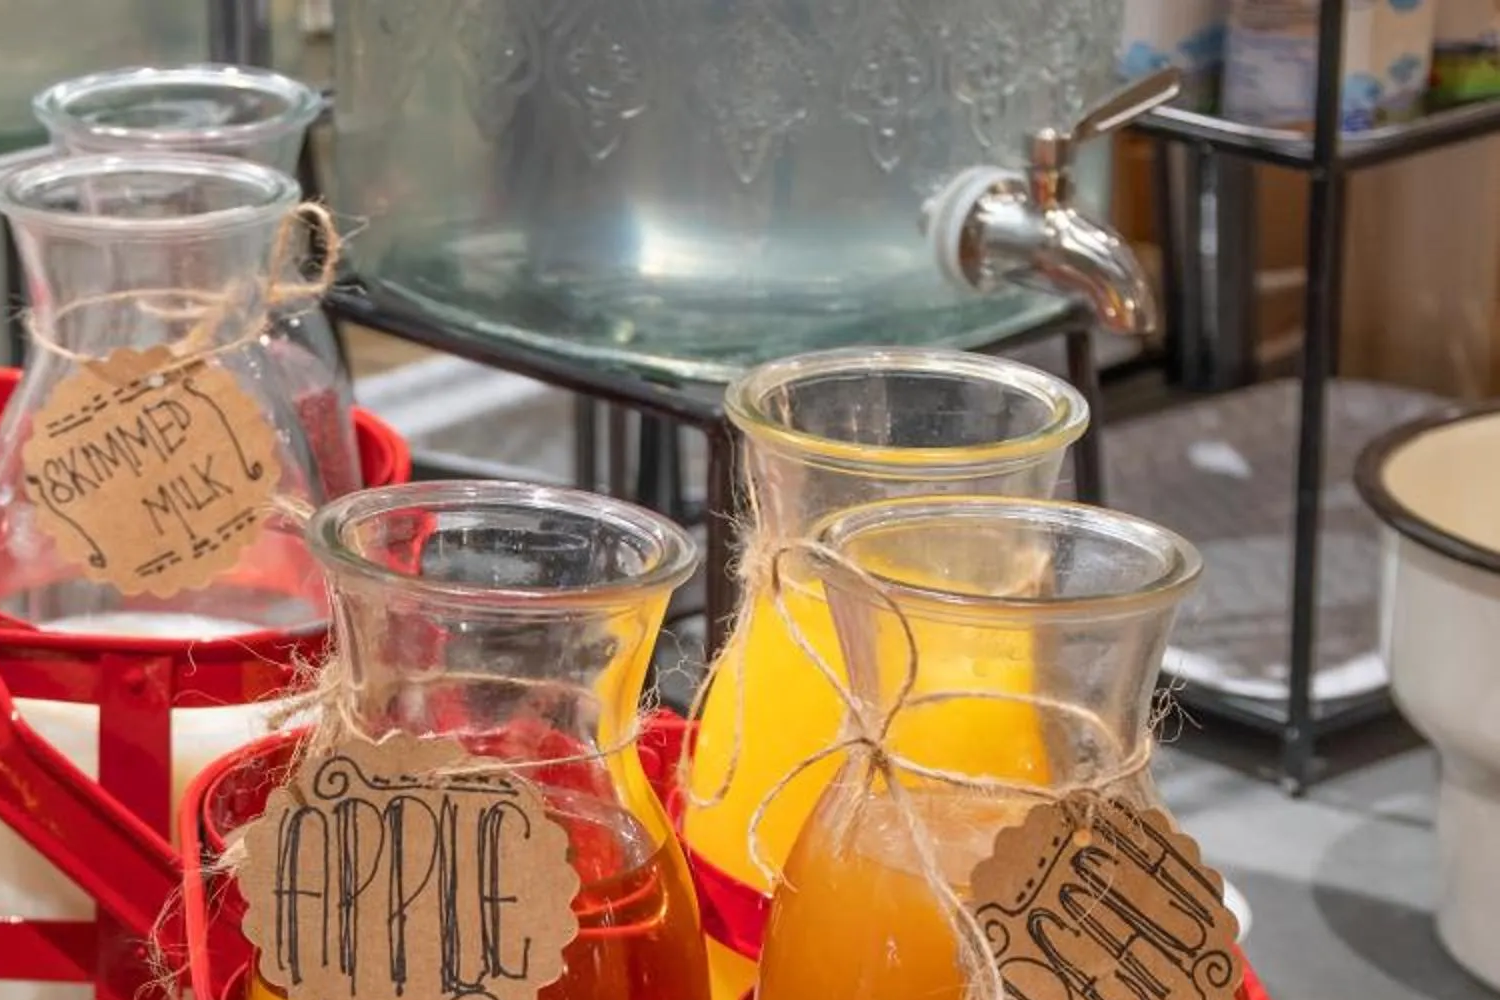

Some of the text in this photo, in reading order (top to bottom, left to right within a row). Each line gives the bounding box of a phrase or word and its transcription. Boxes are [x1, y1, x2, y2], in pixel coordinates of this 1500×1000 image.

[42, 400, 192, 505] SKIMMED
[140, 455, 234, 542] MILK
[273, 794, 532, 998] APPLE
